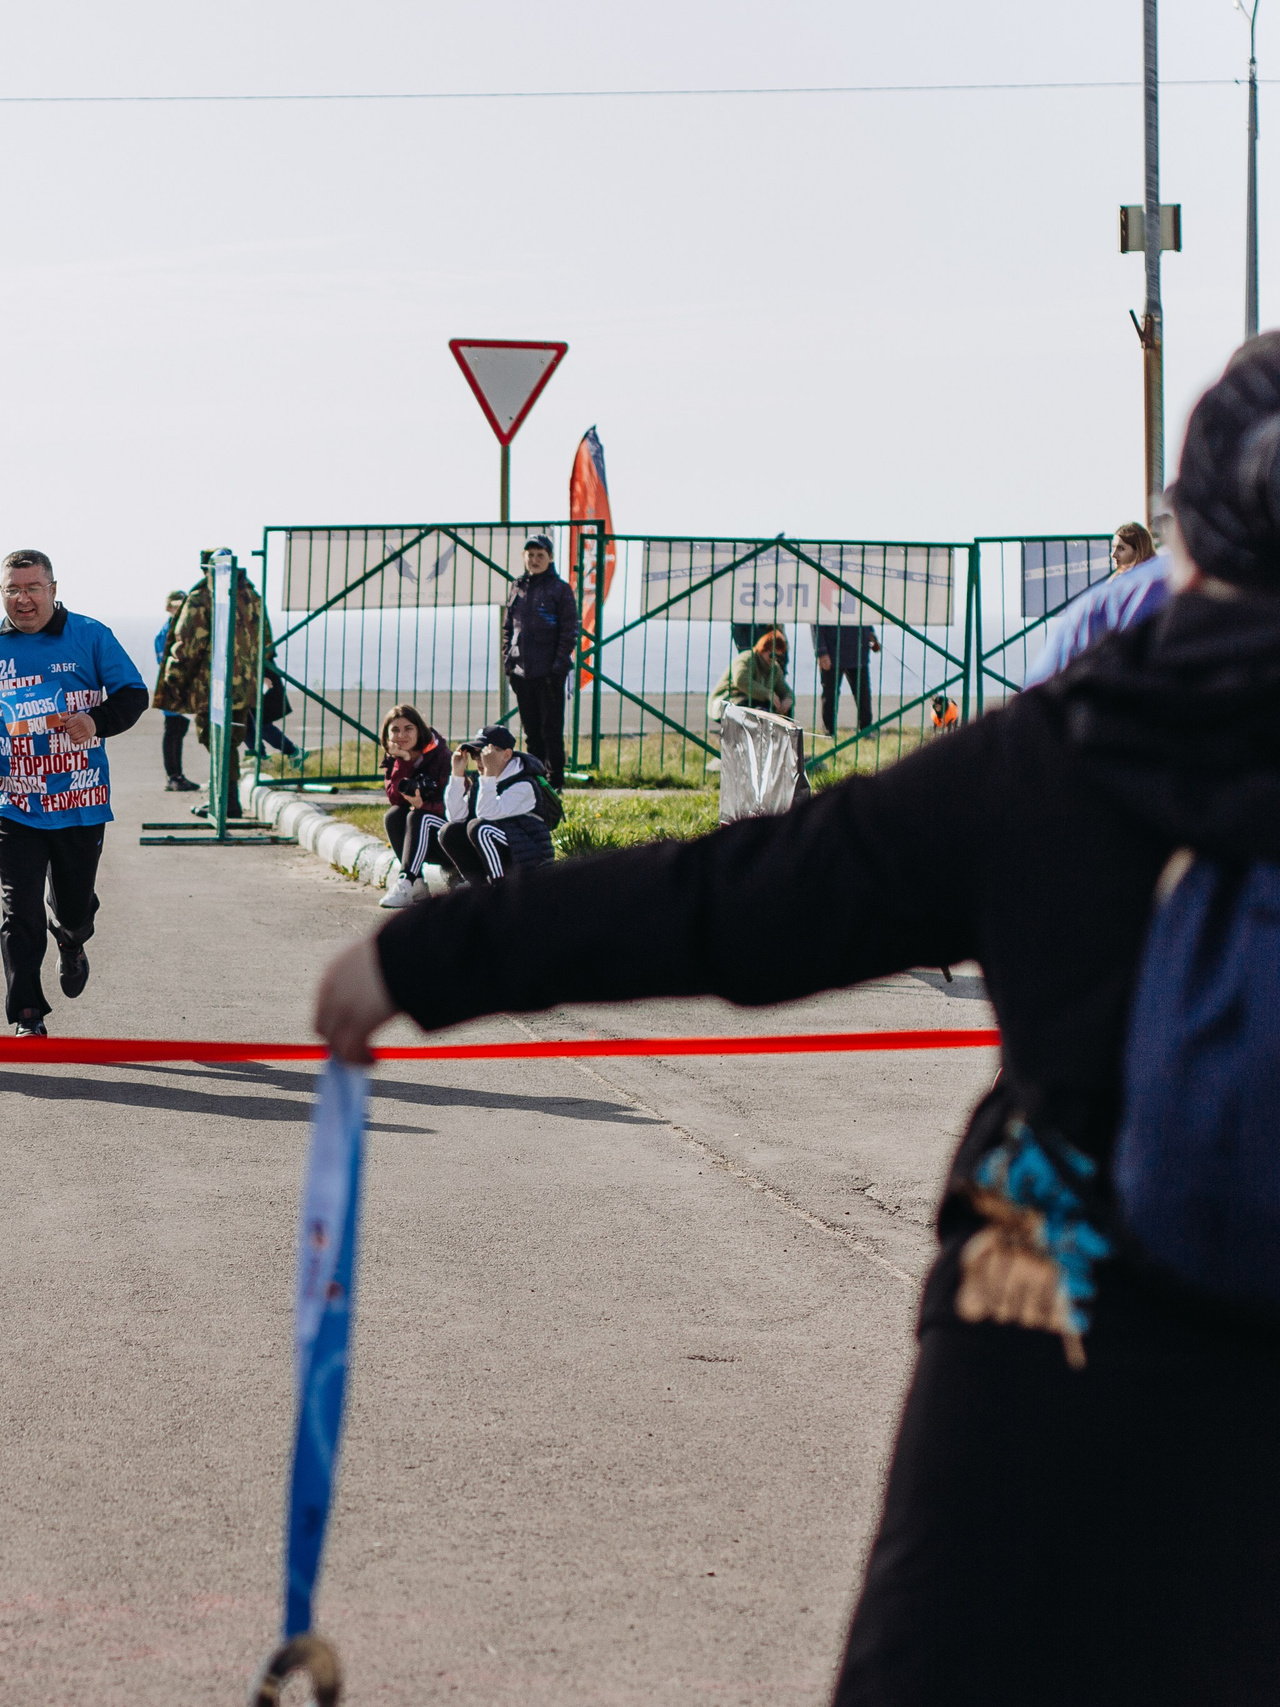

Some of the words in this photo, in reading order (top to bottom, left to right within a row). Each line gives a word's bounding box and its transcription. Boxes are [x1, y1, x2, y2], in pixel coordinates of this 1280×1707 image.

[15, 697, 56, 719] 20035
[9, 751, 88, 776] #ГОРДОСТЬ
[70, 767, 100, 790] 2024
[40, 784, 108, 812] #ЕДИНСТВО
